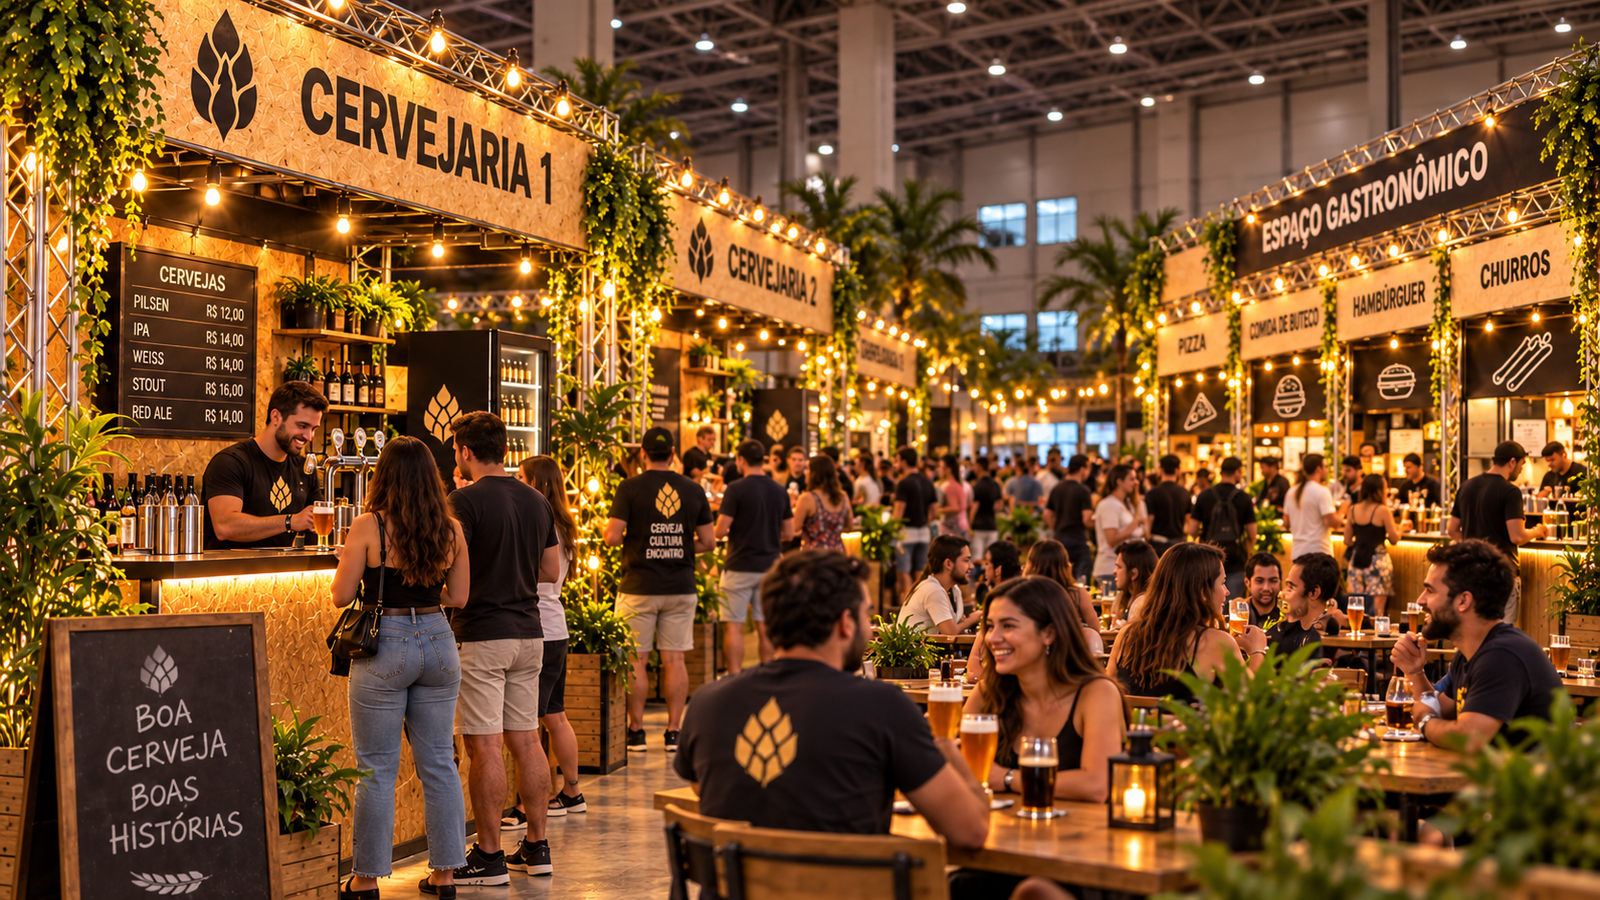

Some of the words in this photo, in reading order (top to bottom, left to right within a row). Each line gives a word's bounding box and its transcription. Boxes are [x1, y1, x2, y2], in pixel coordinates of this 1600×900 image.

[301, 67, 532, 199] CERVEJARIA
[541, 152, 552, 205] 1
[1262, 203, 1323, 254] ESPAÇO
[1326, 141, 1489, 231] GASTRONÔMICO
[159, 265, 226, 292] CERVEJAS
[728, 243, 808, 304] CERVEJARIA
[810, 275, 817, 308] 2
[1480, 249, 1551, 289] CHURROS
[133, 294, 170, 312] PILSEN
[206, 304, 218, 319] R$
[220, 306, 245, 322] 12,00
[133, 321, 150, 337] IPA
[206, 330, 218, 345] R$
[220, 332, 245, 348] 14,00
[1249, 317, 1278, 340] COMIDA
[1278, 314, 1288, 333] DE
[1178, 333, 1207, 356] PIZZA
[132, 349, 165, 365] WEISS
[205, 356, 217, 371] R$
[219, 357, 244, 373] 14,00
[132, 377, 166, 392] STOUT
[205, 381, 217, 397] R$
[219, 383, 244, 398] 16,00
[132, 405, 152, 420] RED
[153, 406, 173, 420] ALE
[204, 408, 217, 424] R$
[218, 409, 244, 425] 14,00
[649, 535, 683, 547] CULTURA
[650, 523, 684, 534] CERVEJA
[646, 548, 684, 560] ENCONTRO
[136, 699, 192, 733] BOA
[106, 729, 228, 774] CERVEJA
[131, 776, 199, 812] BOAS
